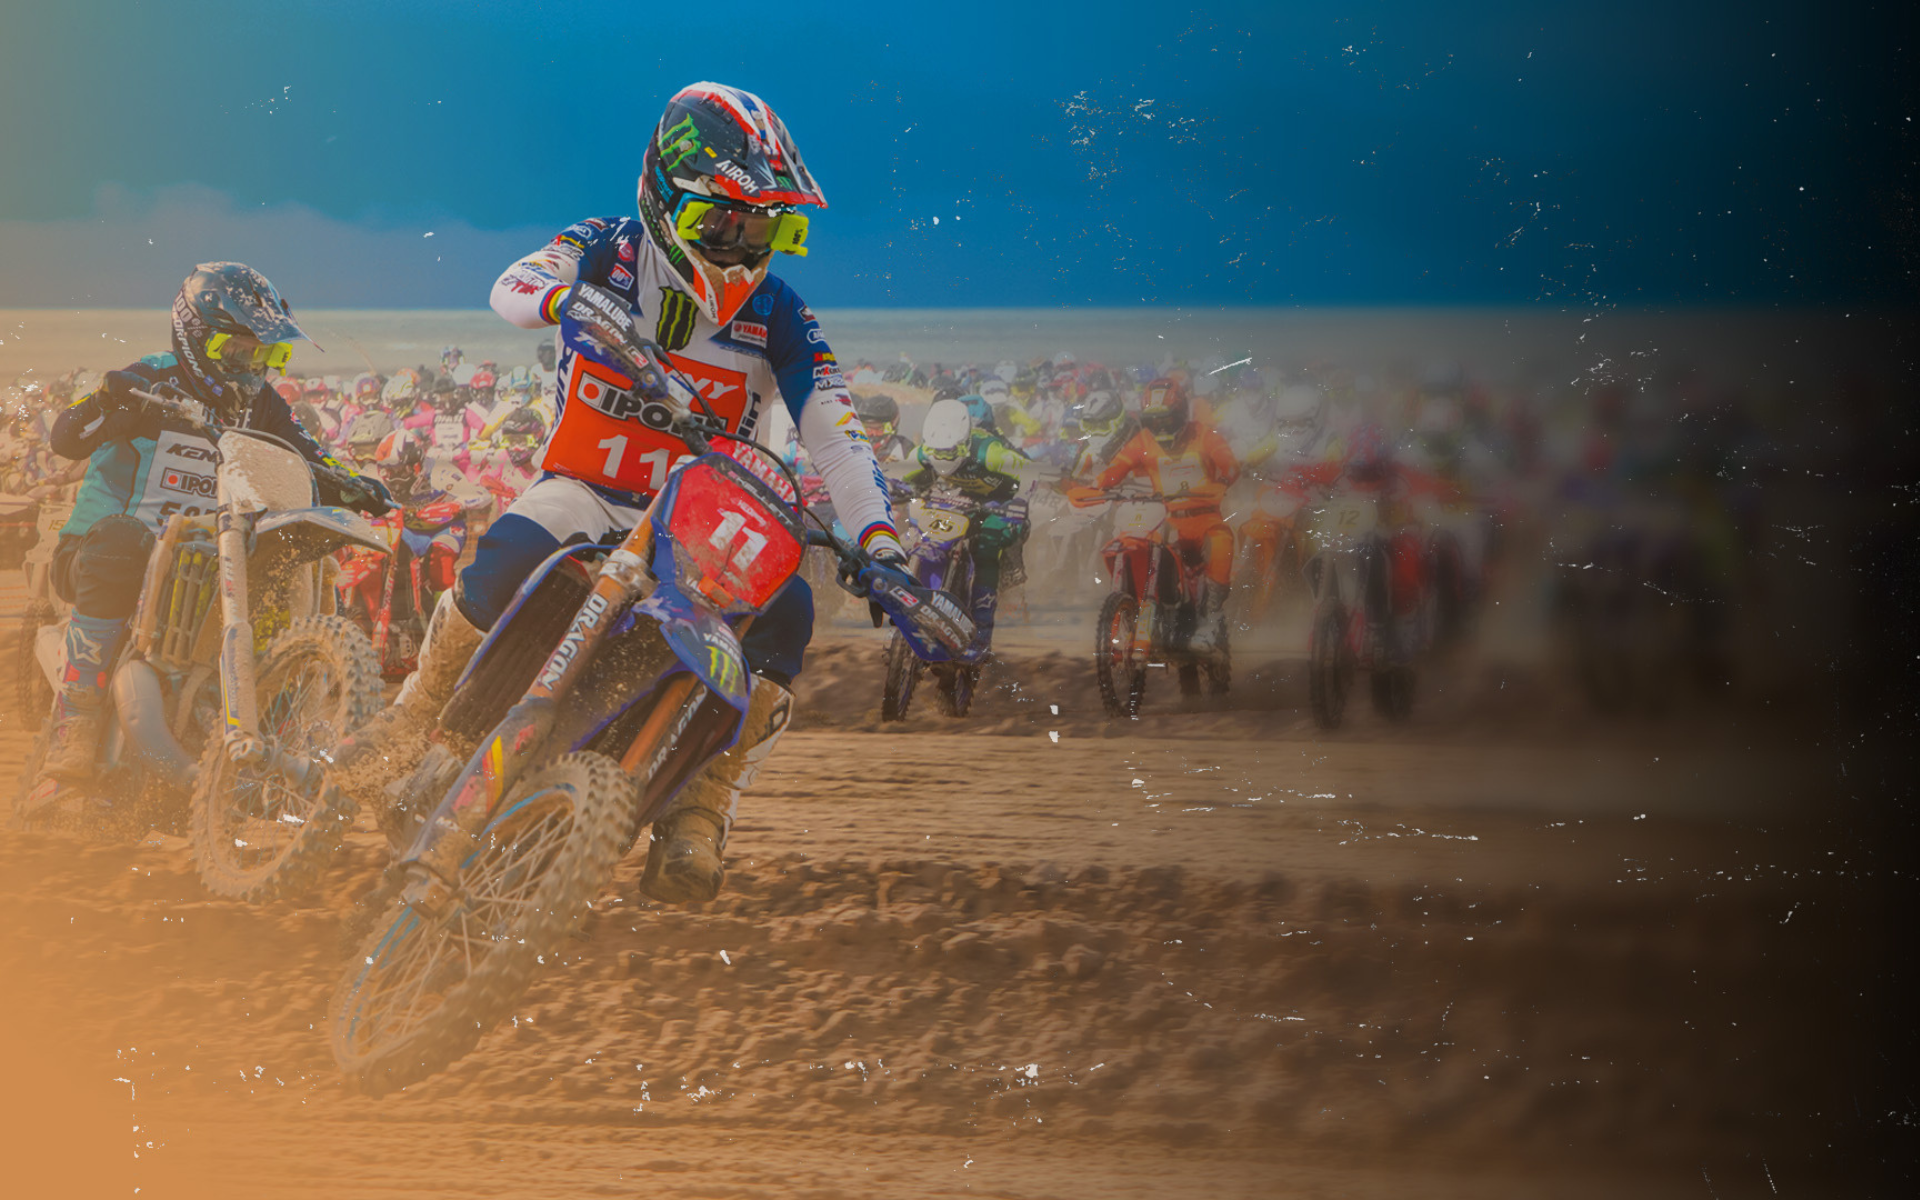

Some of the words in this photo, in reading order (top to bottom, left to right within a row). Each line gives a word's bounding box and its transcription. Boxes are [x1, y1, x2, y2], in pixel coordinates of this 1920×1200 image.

[715, 159, 760, 194] AIROH
[572, 301, 629, 344] DRAGON
[578, 283, 633, 332] YAMALUBE
[172, 310, 206, 379] ORPION
[600, 386, 728, 441] IPO
[166, 443, 219, 464] KEN
[597, 434, 671, 492] 11
[181, 475, 218, 495] IPO
[708, 509, 768, 571] 11
[537, 592, 609, 691] DRAGON
